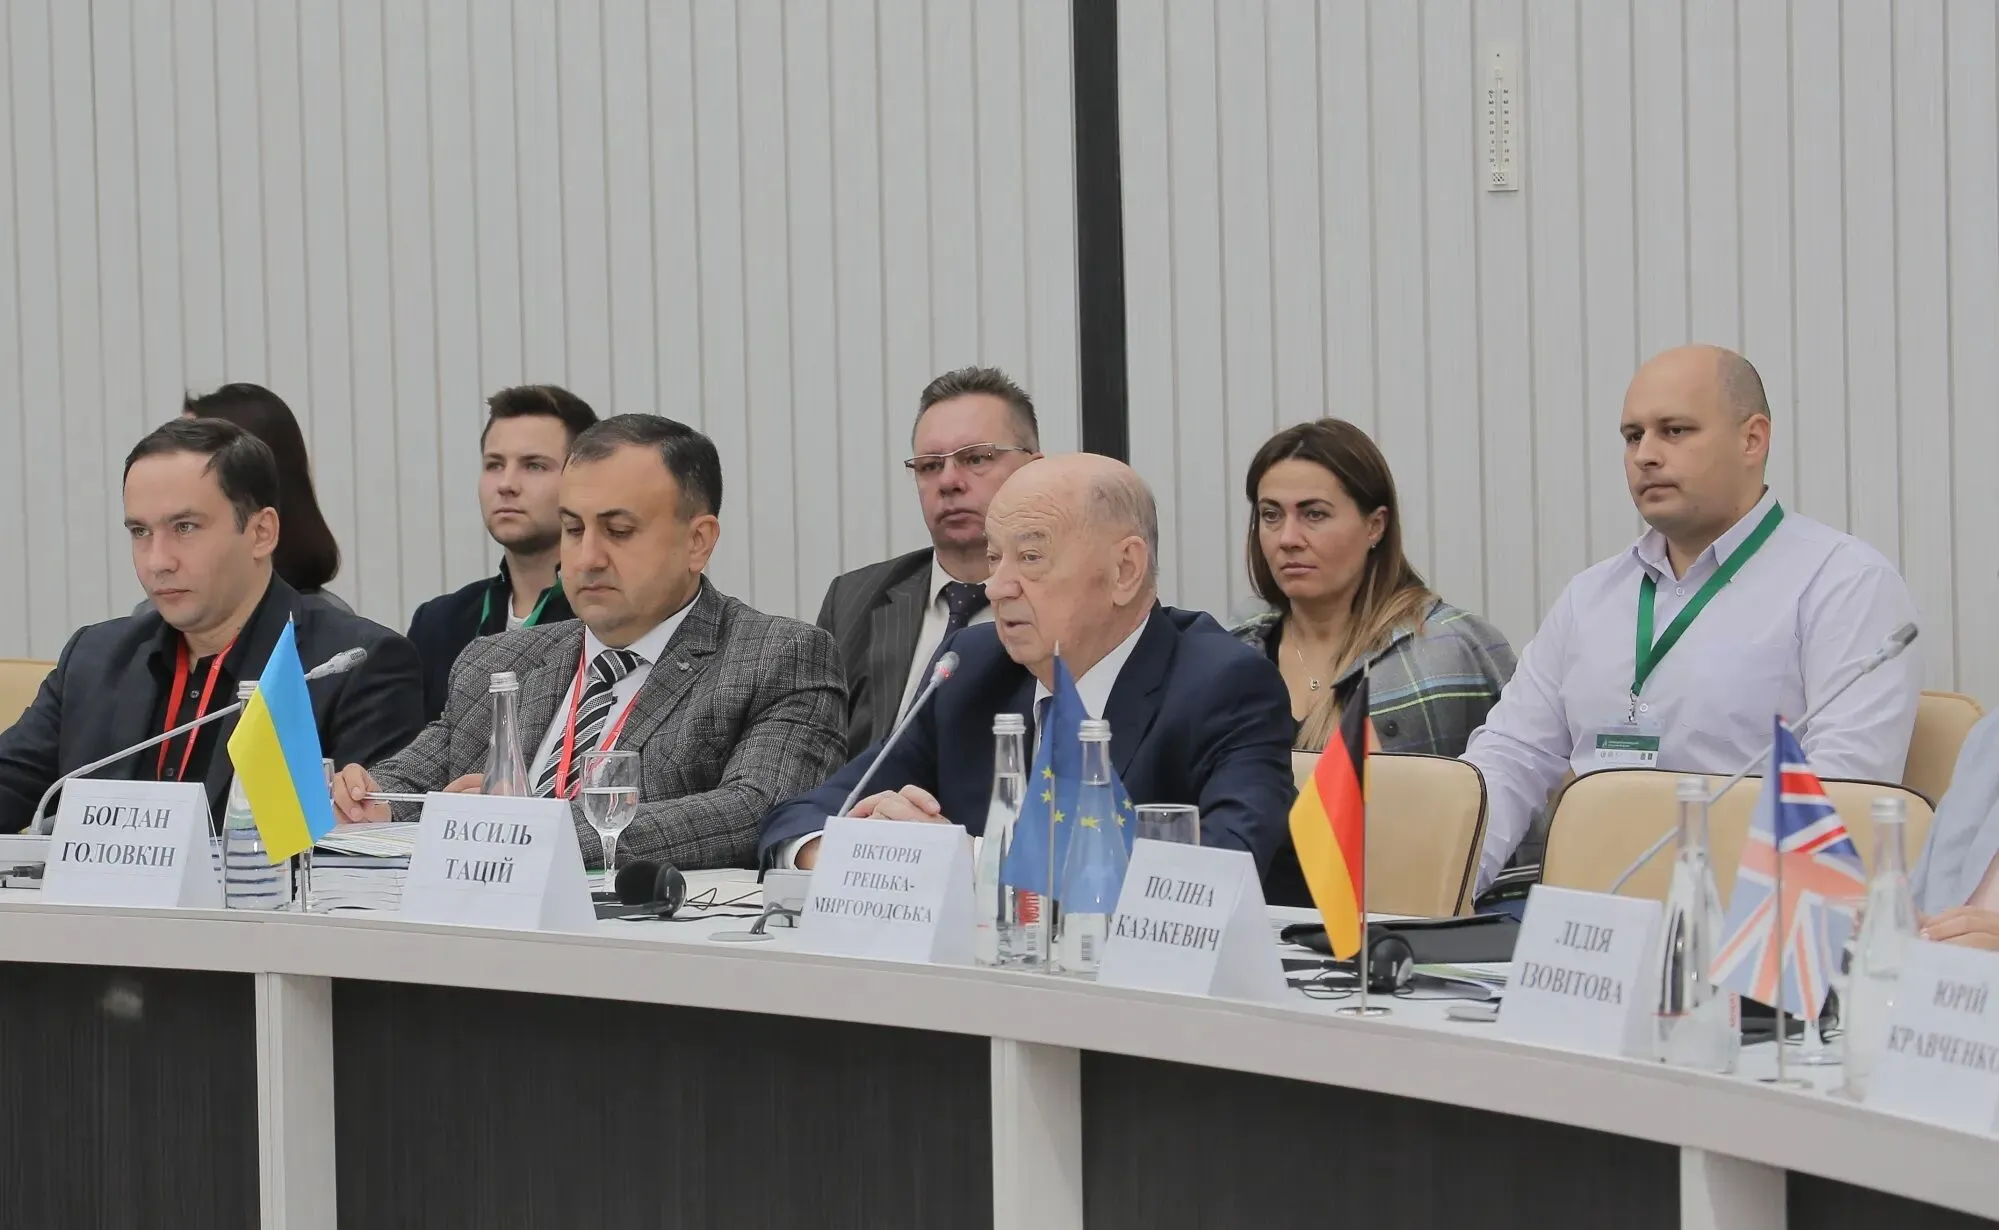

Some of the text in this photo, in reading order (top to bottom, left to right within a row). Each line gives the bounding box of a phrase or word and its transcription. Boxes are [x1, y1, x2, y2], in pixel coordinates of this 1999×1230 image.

[82, 805, 172, 830] БОГДАН
[442, 819, 532, 846] ВАСИЛЬ
[61, 841, 176, 867] ГОЛОВКІН
[851, 843, 922, 864] ВІКТОРІЯ
[445, 856, 515, 886] ТАЦІЙ
[841, 871, 915, 892] ГРЕЦЬКА-
[1144, 875, 1216, 907] ПОЛІНА
[811, 896, 932, 924] МИРГОРОДСЬКА
[1115, 913, 1220, 951] КАЗАКЕВИЧ
[1555, 920, 1614, 953] ЛІДІЯ
[1520, 961, 1622, 1005] ІЗОВІТОВА
[1932, 978, 1989, 1015] ЮРІЙ
